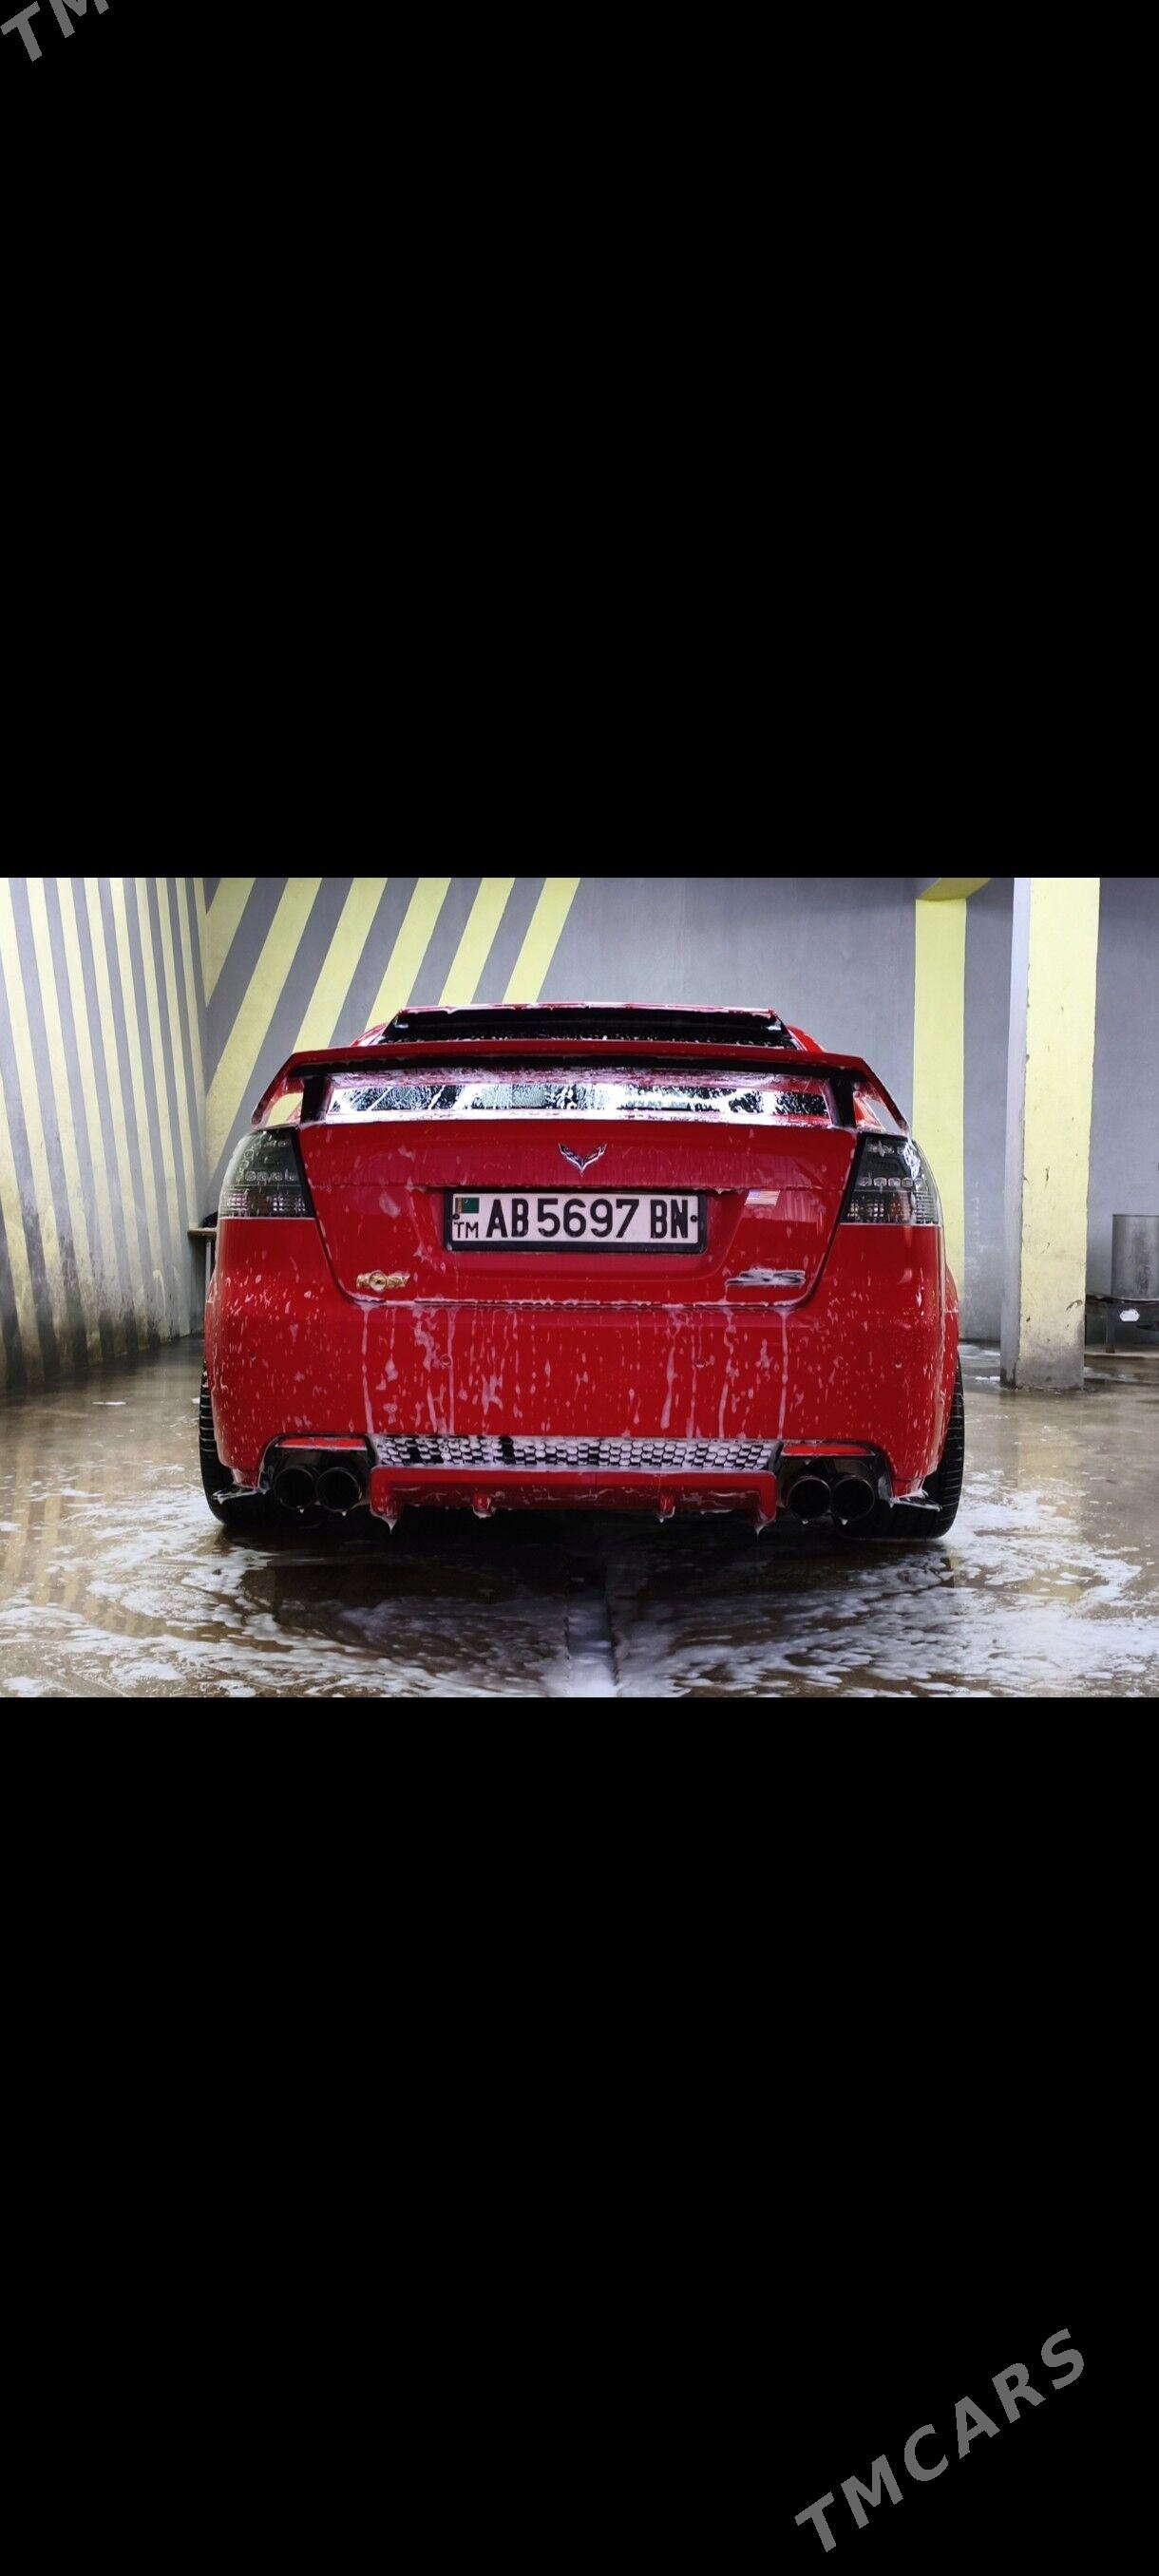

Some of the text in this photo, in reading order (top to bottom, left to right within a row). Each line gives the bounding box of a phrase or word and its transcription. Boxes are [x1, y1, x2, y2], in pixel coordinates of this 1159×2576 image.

[454, 1222, 479, 1239] TM
[485, 1198, 689, 1239] AB 5697 BN
